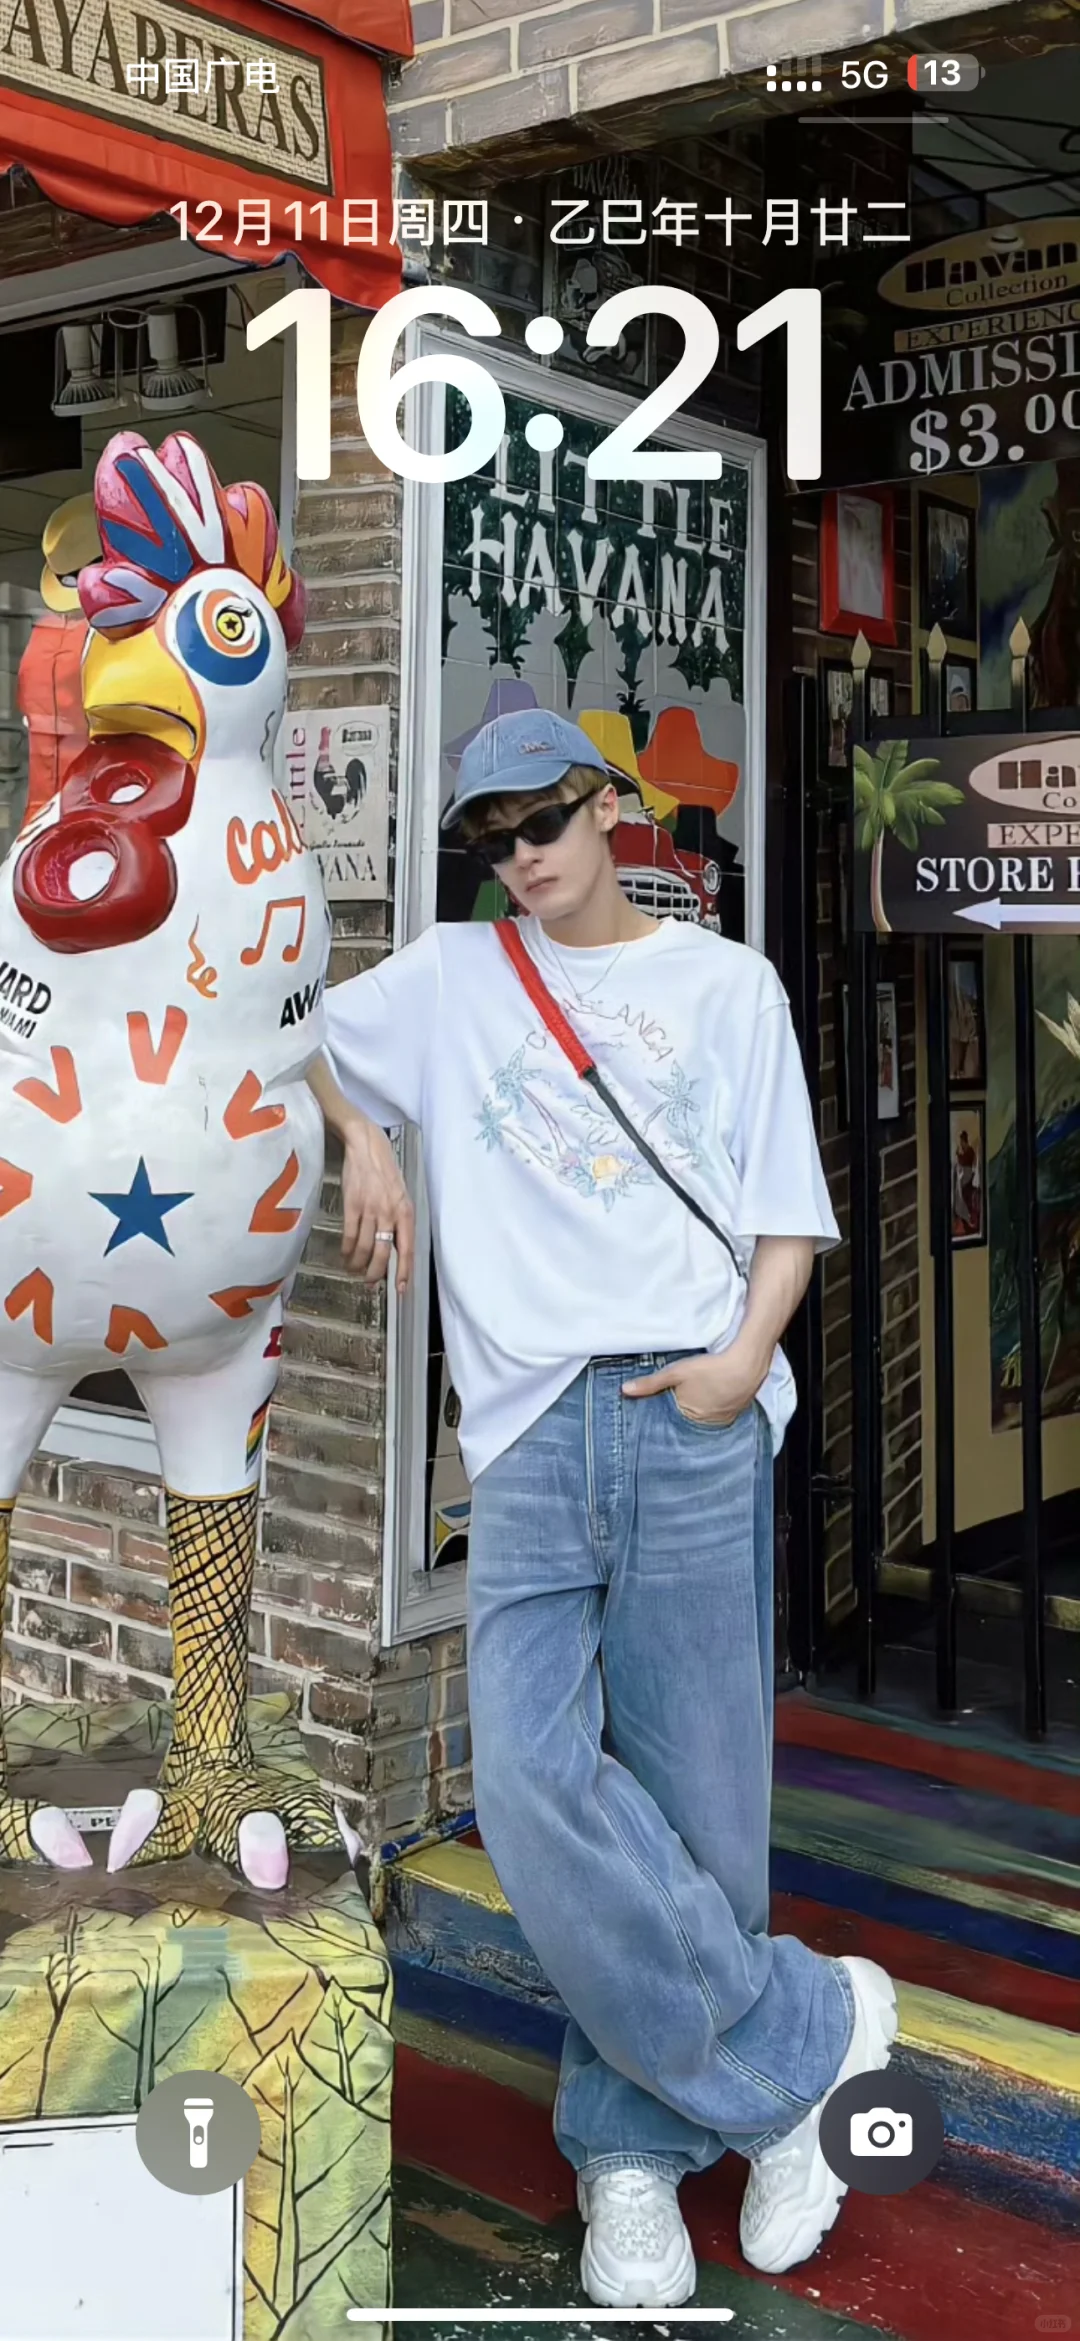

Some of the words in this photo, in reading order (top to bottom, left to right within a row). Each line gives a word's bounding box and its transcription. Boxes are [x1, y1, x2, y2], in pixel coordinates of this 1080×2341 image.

[946, 272, 1068, 307] Collection
[489, 432, 733, 560] LITTLE
[464, 499, 731, 655] HAVANA
[916, 856, 1054, 893] STORE
